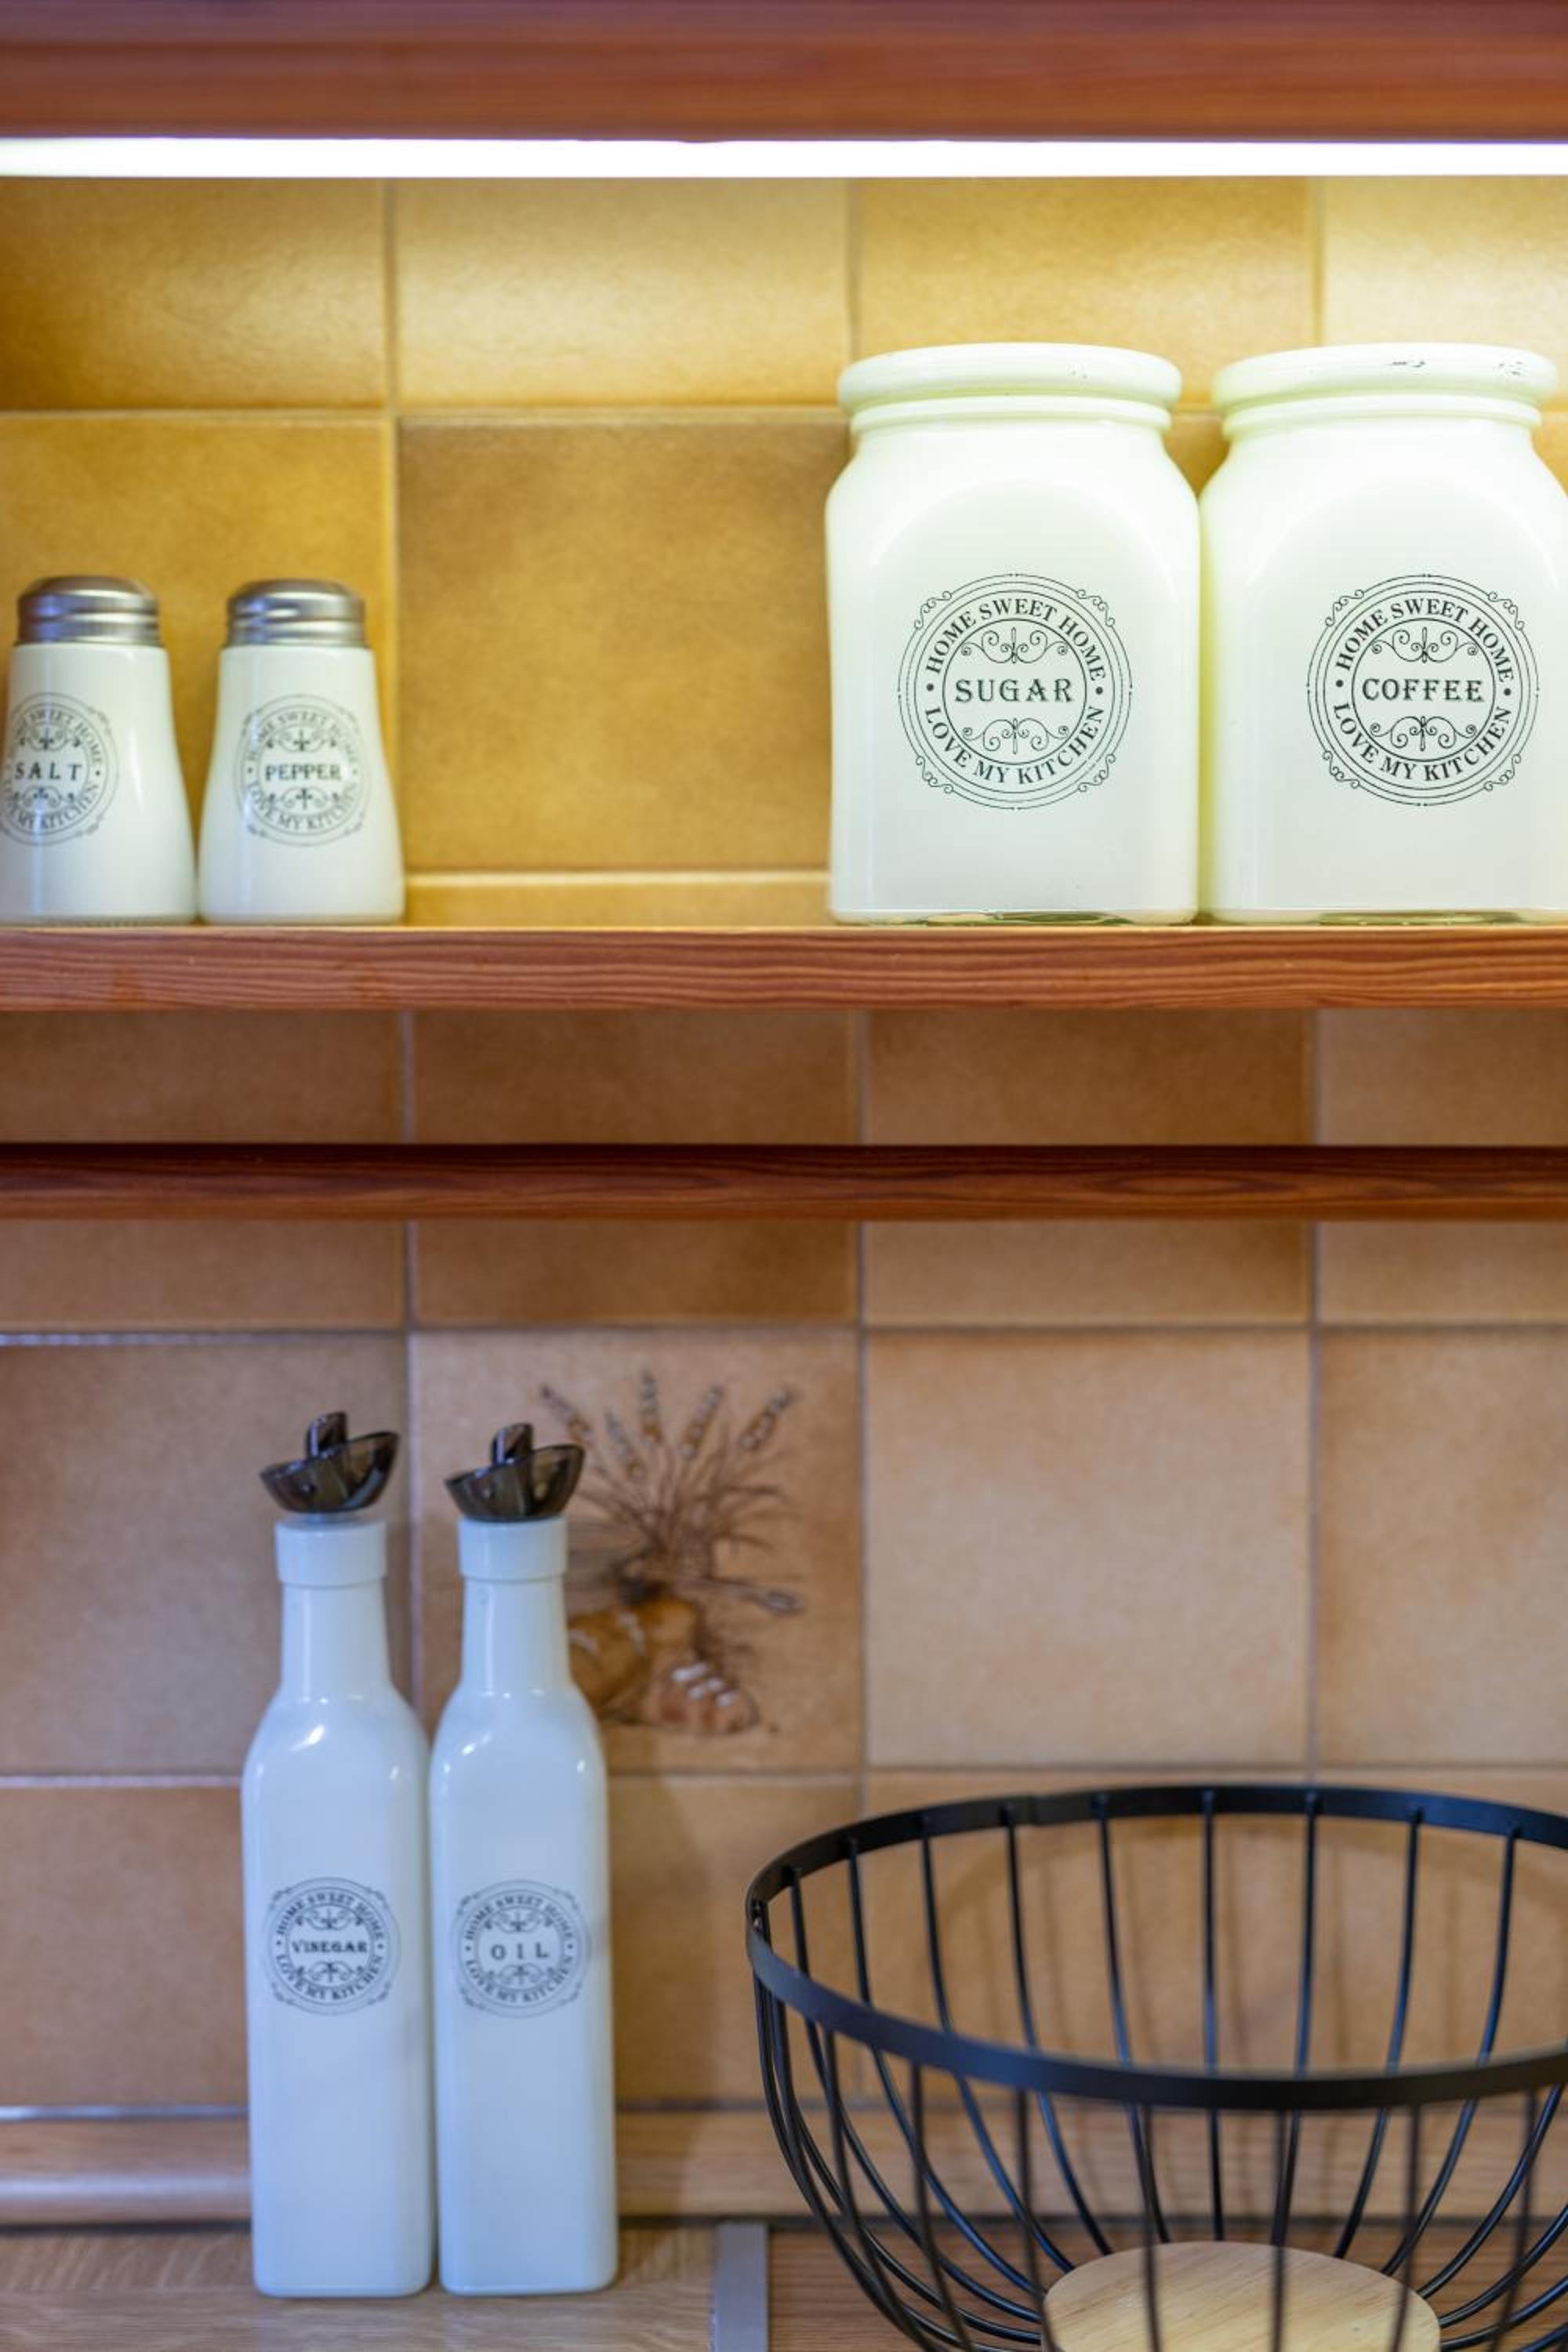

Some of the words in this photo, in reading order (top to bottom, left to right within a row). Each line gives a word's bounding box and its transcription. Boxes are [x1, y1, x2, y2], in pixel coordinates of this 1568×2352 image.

[926, 610, 977, 674] HOME
[978, 597, 1058, 622] SWEET
[1058, 615, 1106, 682] HOME
[1335, 609, 1388, 672] HOME
[1390, 597, 1468, 623] SWEET
[1468, 617, 1515, 683] HOME
[954, 677, 1075, 703] SUGAR
[1362, 677, 1484, 703] COFFEE
[925, 706, 972, 768] LOVE
[973, 760, 1010, 784] MY
[1018, 706, 1105, 785] KITCHEN
[1333, 702, 1380, 764] LOVE
[1380, 756, 1417, 780] MY
[1424, 706, 1512, 782] KITCHEN
[14, 760, 82, 780] SALT
[265, 764, 342, 781] PEPPER
[291, 1940, 368, 1953] VINEGAR
[490, 1941, 550, 1960] OIL
